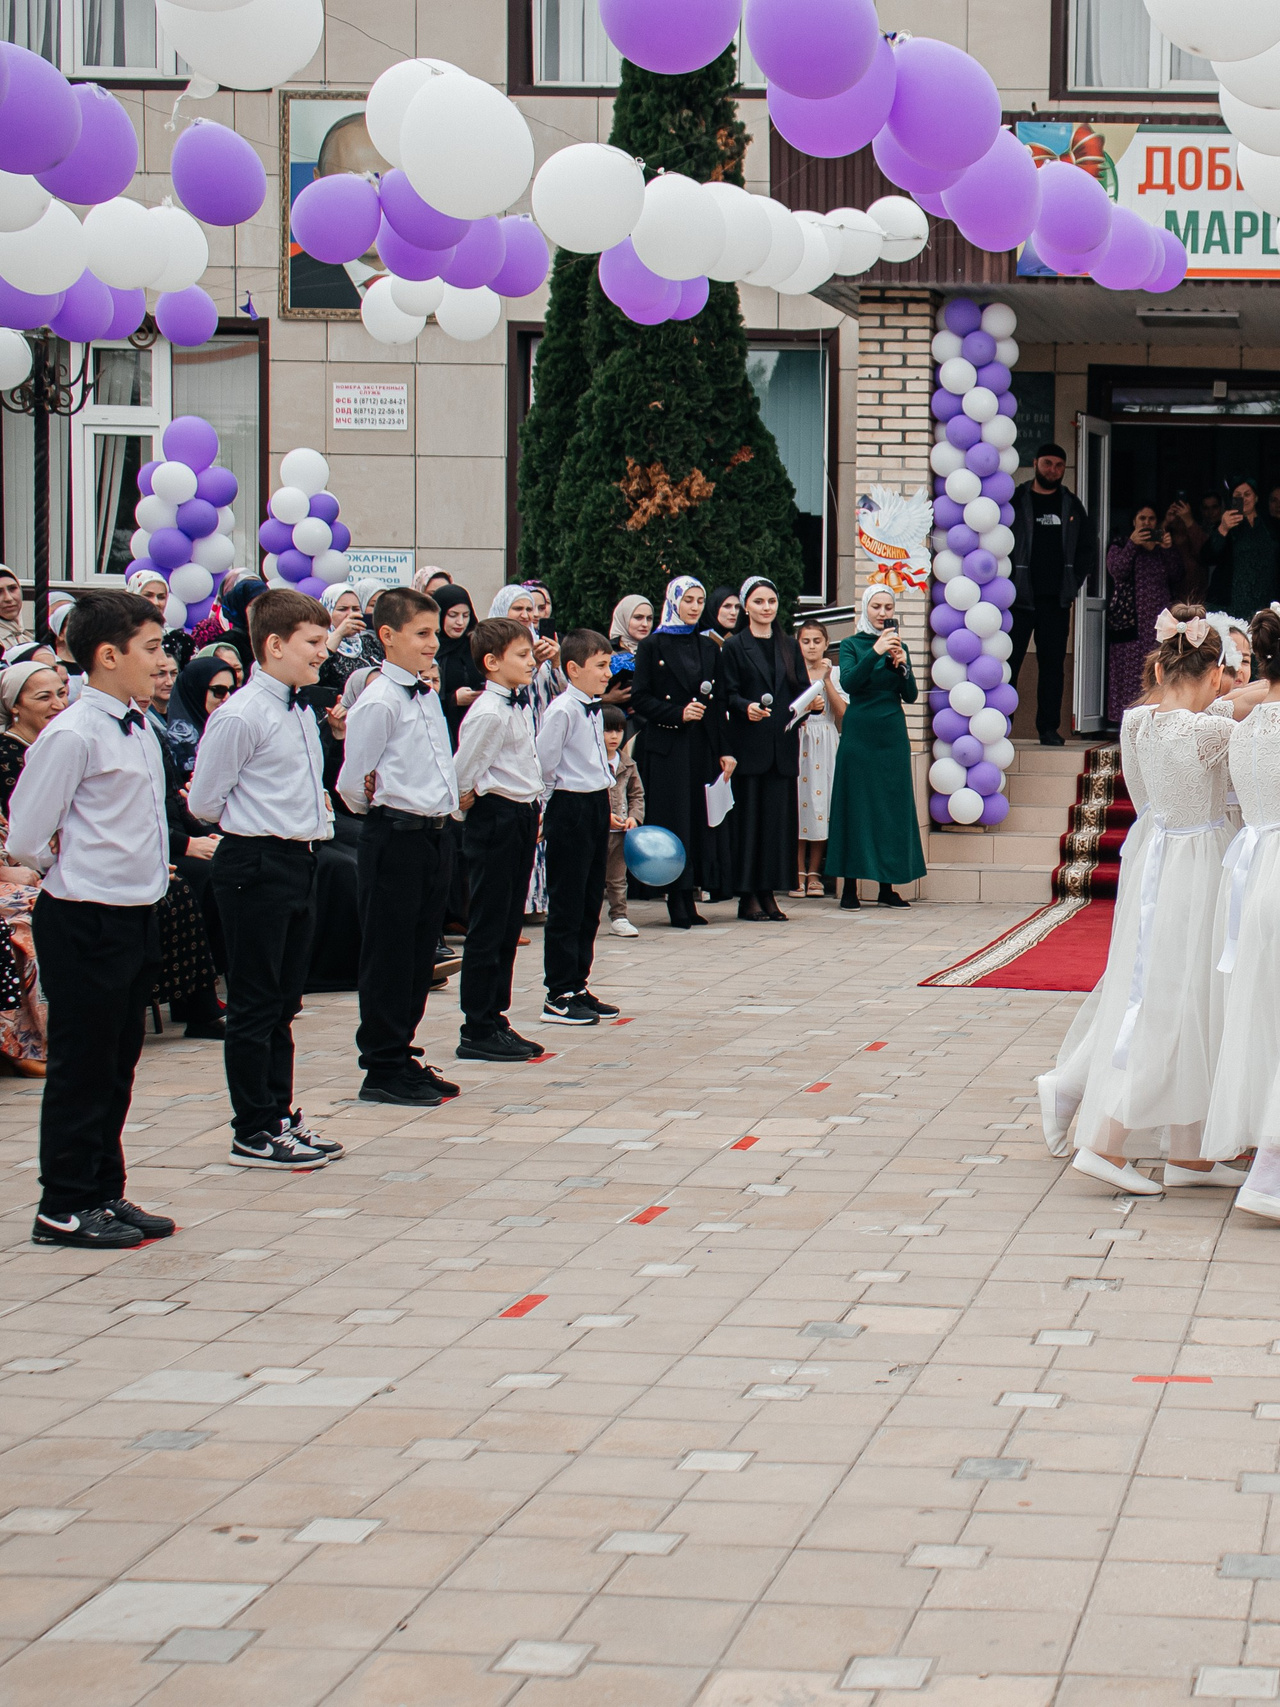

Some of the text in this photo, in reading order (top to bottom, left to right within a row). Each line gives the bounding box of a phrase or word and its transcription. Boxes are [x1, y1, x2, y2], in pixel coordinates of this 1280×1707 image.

[1138, 146, 1245, 195] ДОБ
[1165, 210, 1280, 255] МАР
[353, 397, 358, 405] 8
[359, 397, 378, 405] (8712)
[379, 397, 406, 405] 62-84-21
[335, 407, 352, 415] ОВД
[353, 407, 377, 416] 8(8712)
[335, 417, 352, 425] МЧС
[860, 534, 907, 559] ВЫПУСКНИК
[344, 554, 408, 563] ОЖАРНЫЙ
